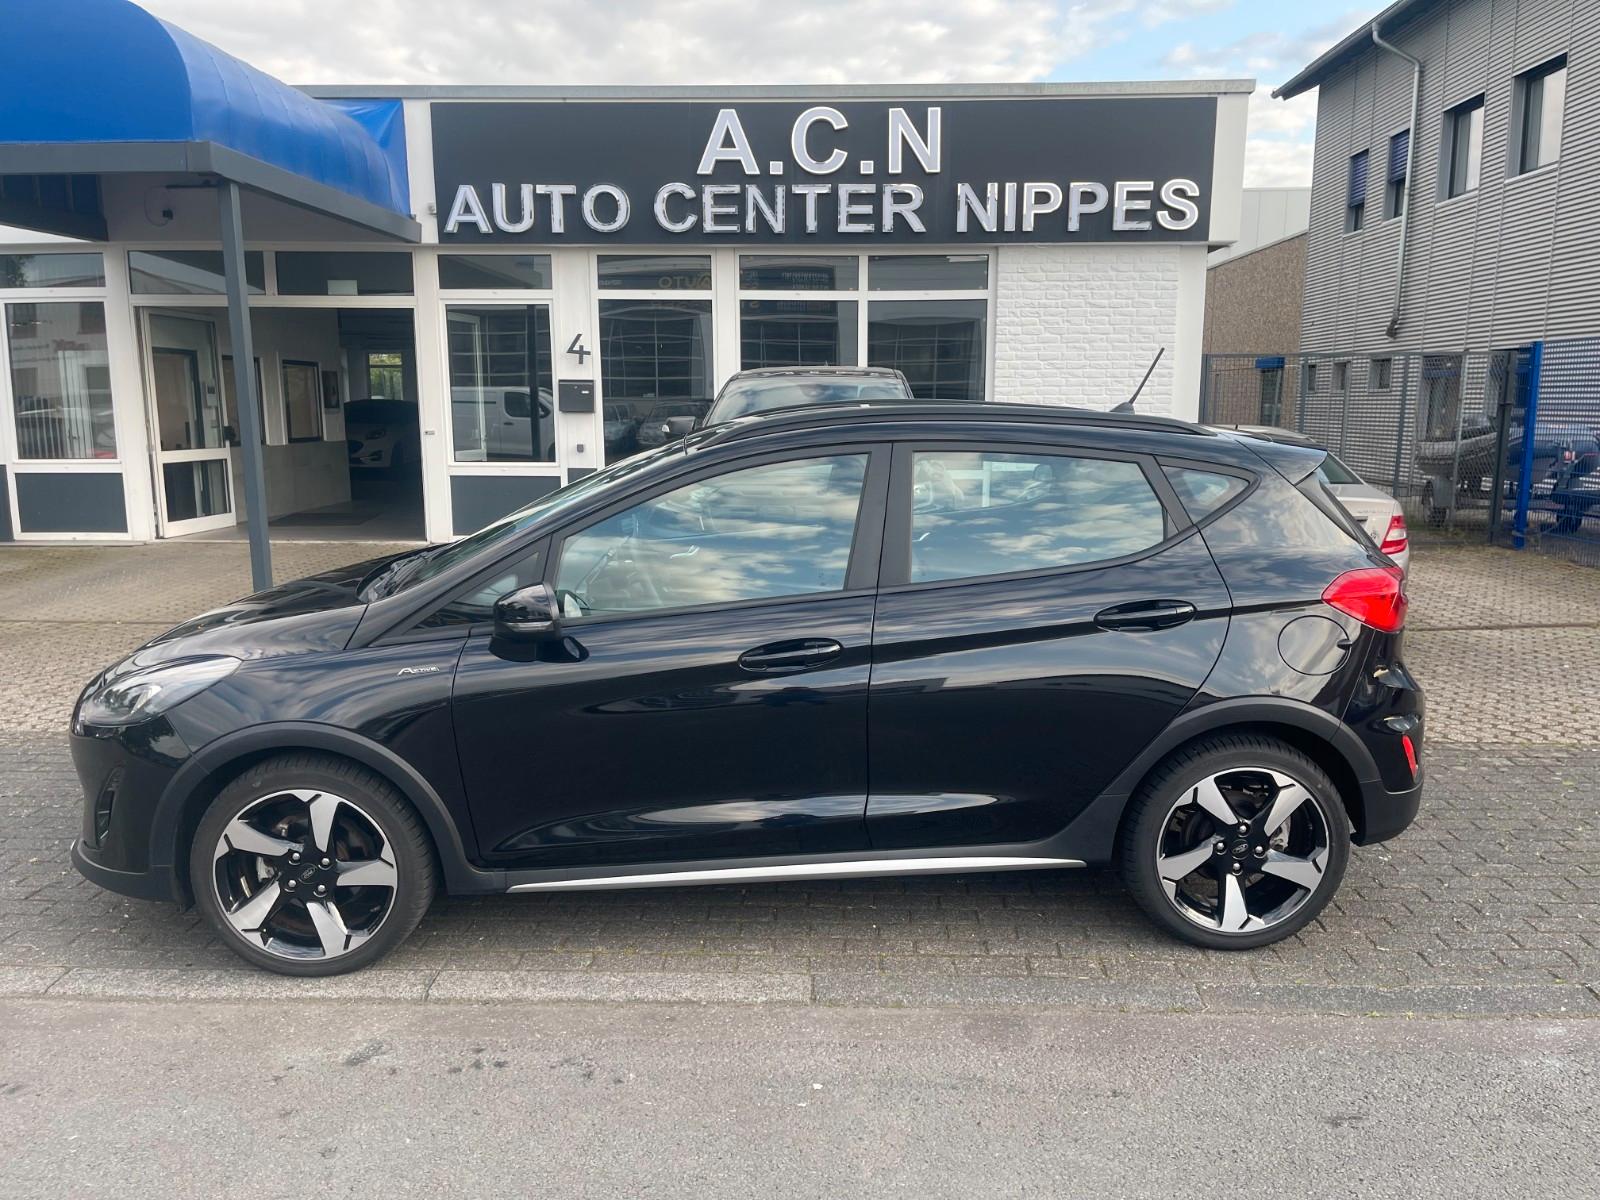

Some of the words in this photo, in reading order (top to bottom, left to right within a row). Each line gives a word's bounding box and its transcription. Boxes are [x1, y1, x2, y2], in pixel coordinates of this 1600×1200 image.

[697, 106, 942, 174] A.C.N
[444, 183, 631, 233] AUTO
[653, 182, 927, 233] CENTER
[956, 178, 1200, 233] NIPPES
[566, 333, 592, 365] 4
